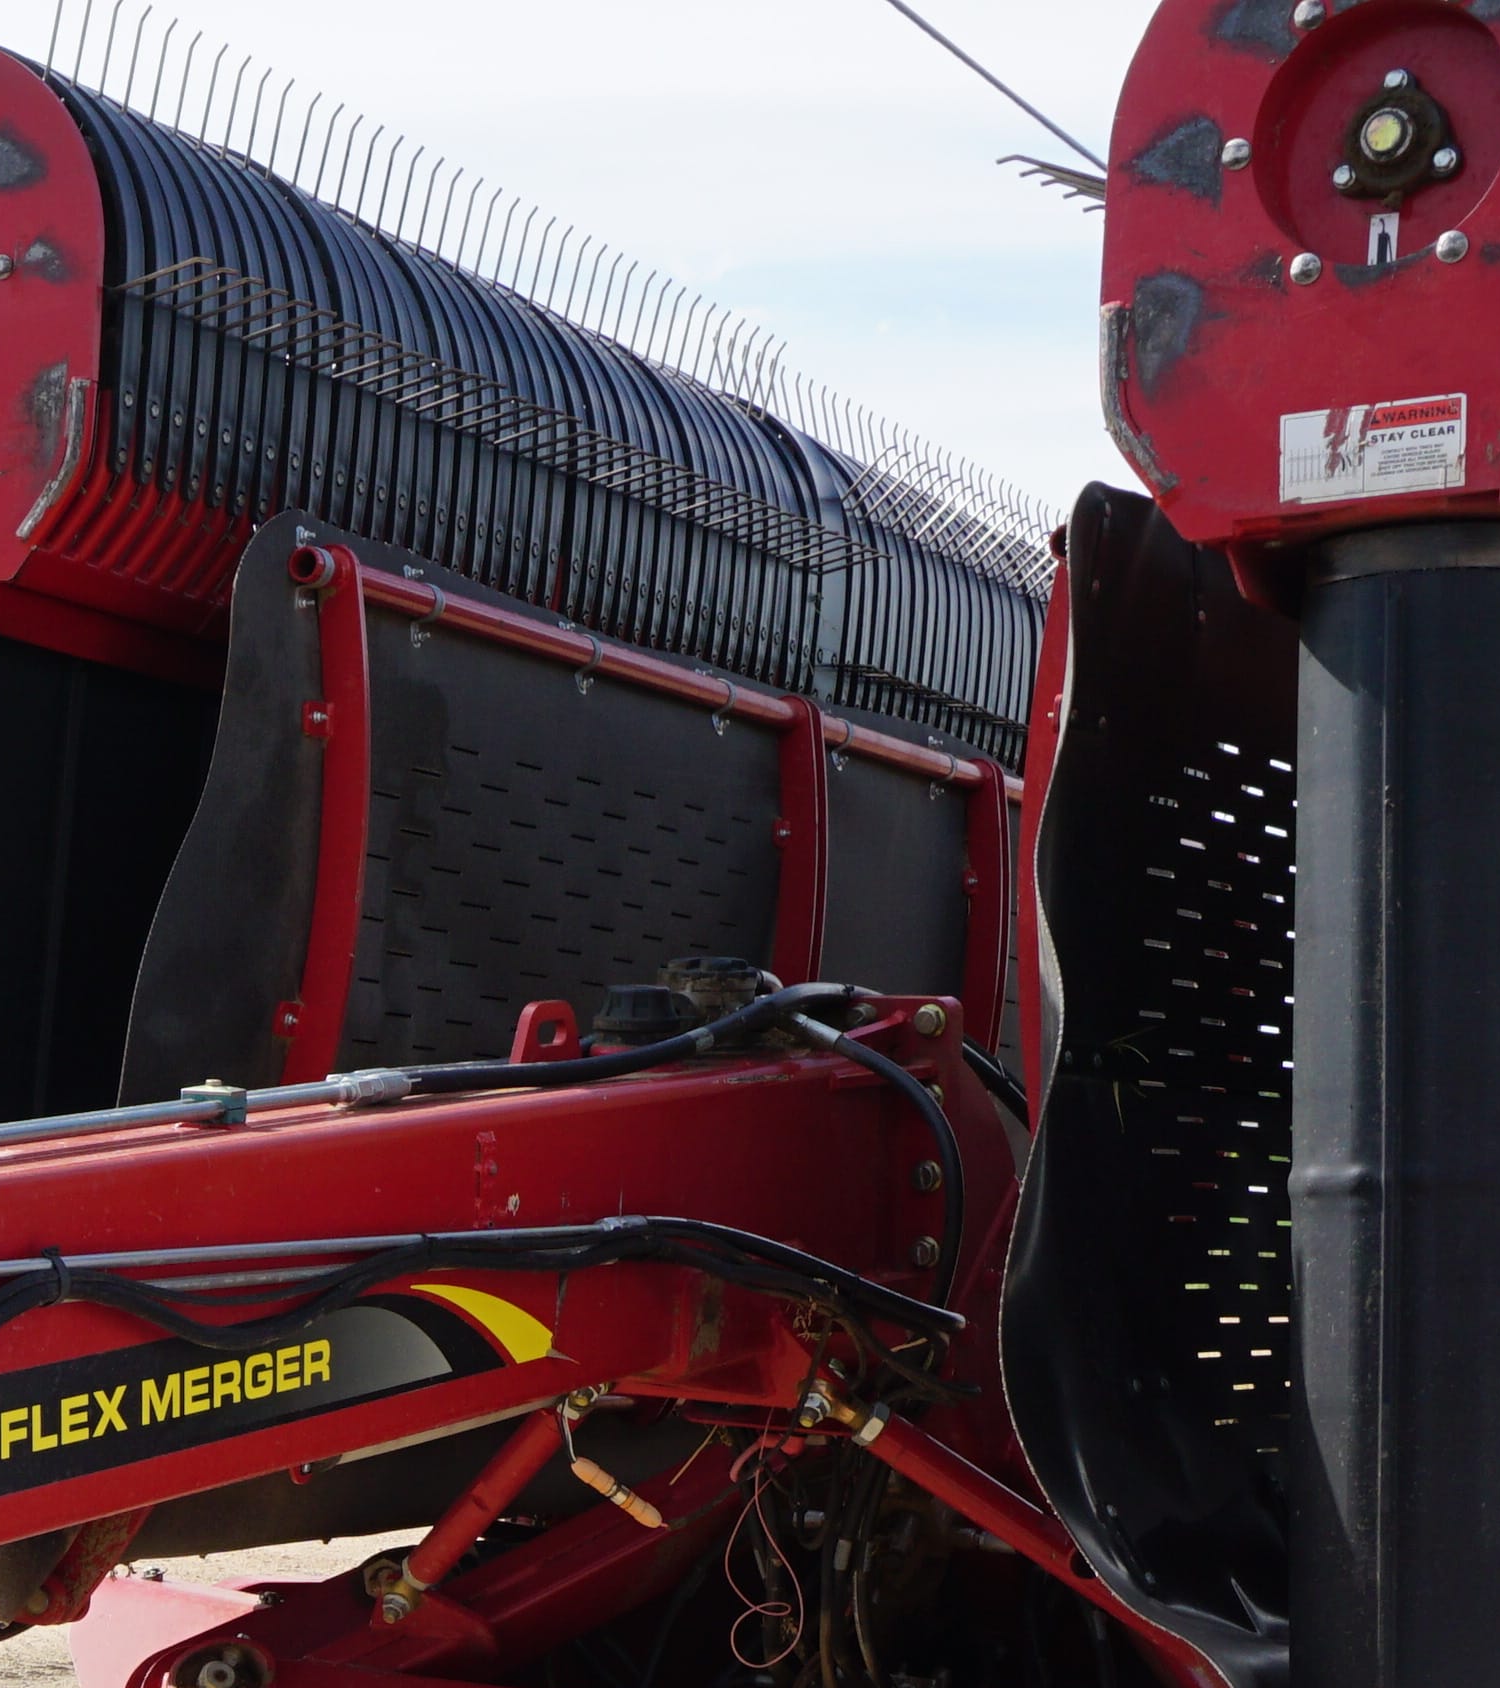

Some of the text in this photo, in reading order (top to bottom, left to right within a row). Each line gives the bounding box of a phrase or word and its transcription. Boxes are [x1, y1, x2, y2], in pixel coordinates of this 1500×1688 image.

[1383, 405, 1457, 422] WARNING
[1371, 426, 1455, 443] STAY CLEAR
[140, 1338, 332, 1425] MERGER
